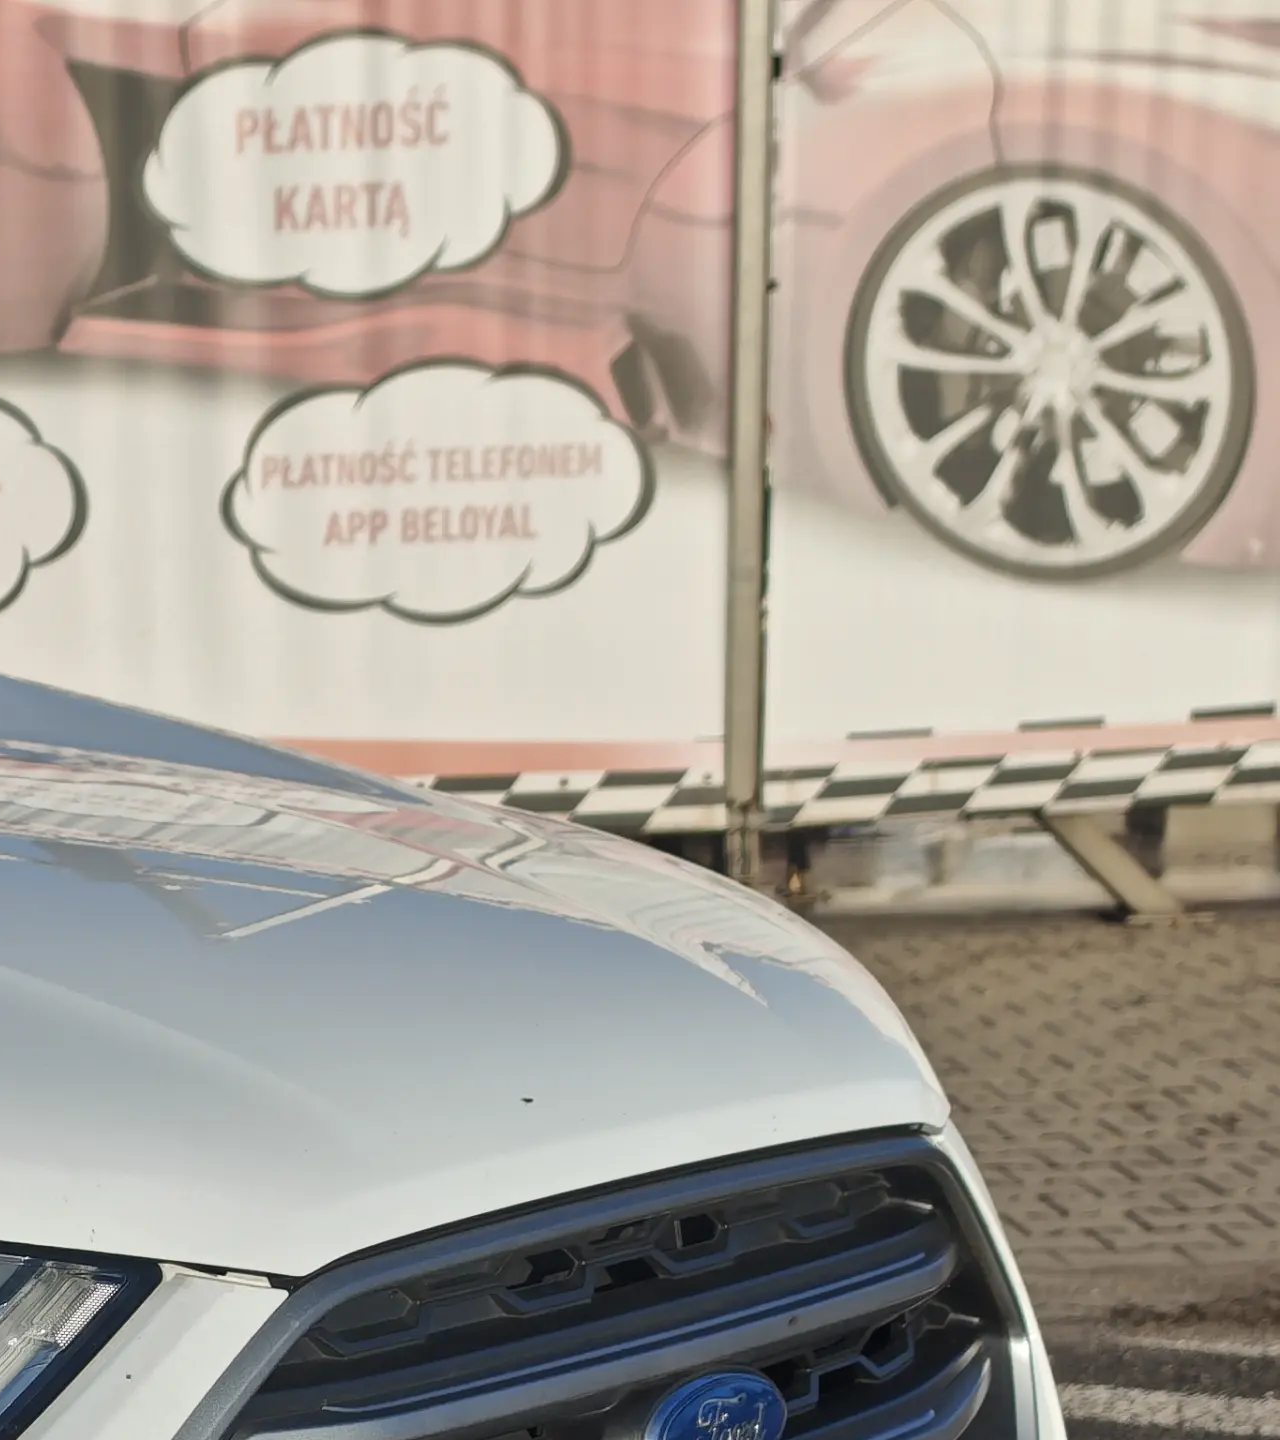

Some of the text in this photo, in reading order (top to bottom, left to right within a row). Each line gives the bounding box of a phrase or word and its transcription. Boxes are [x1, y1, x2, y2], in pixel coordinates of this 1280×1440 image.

[235, 83, 451, 155] PŁATNOŚĆ
[272, 180, 412, 238] KARTĄ
[261, 439, 604, 490] PŁATNOŚĆ TELEFONEM
[323, 503, 538, 548] APP BELOYAL
